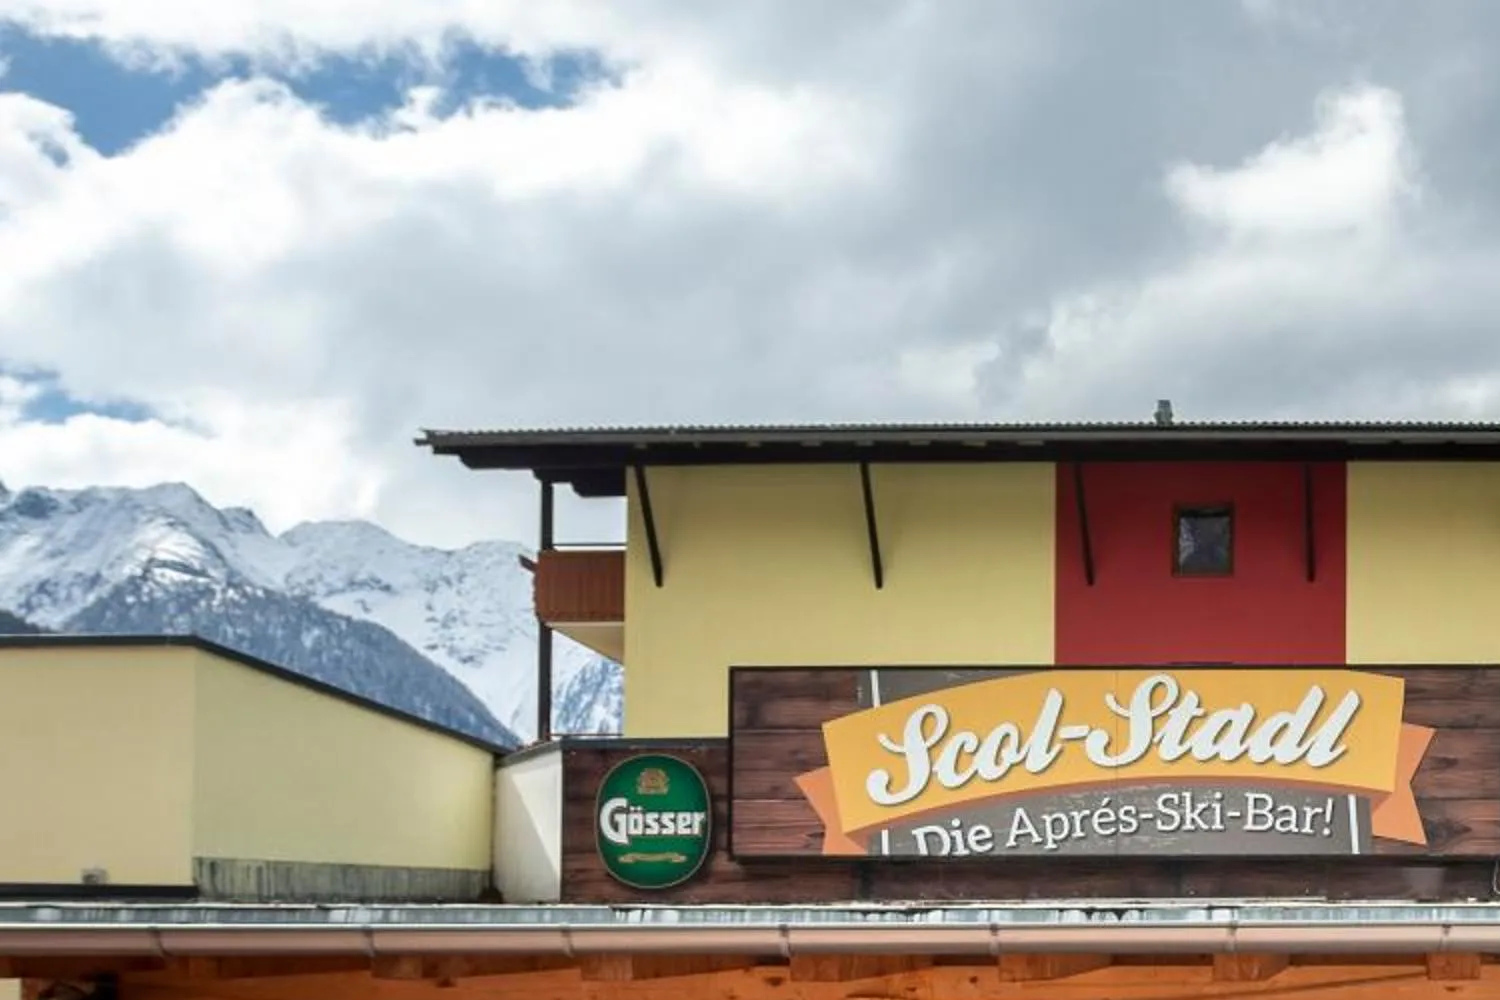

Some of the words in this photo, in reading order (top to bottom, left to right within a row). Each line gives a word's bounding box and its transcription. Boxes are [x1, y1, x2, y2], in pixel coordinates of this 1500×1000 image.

[866, 674, 1360, 805] Scol-Stadl
[600, 797, 705, 844] Gösser
[912, 818, 993, 856] Die
[1006, 791, 1333, 850] Aprés-Ski-Bar!
